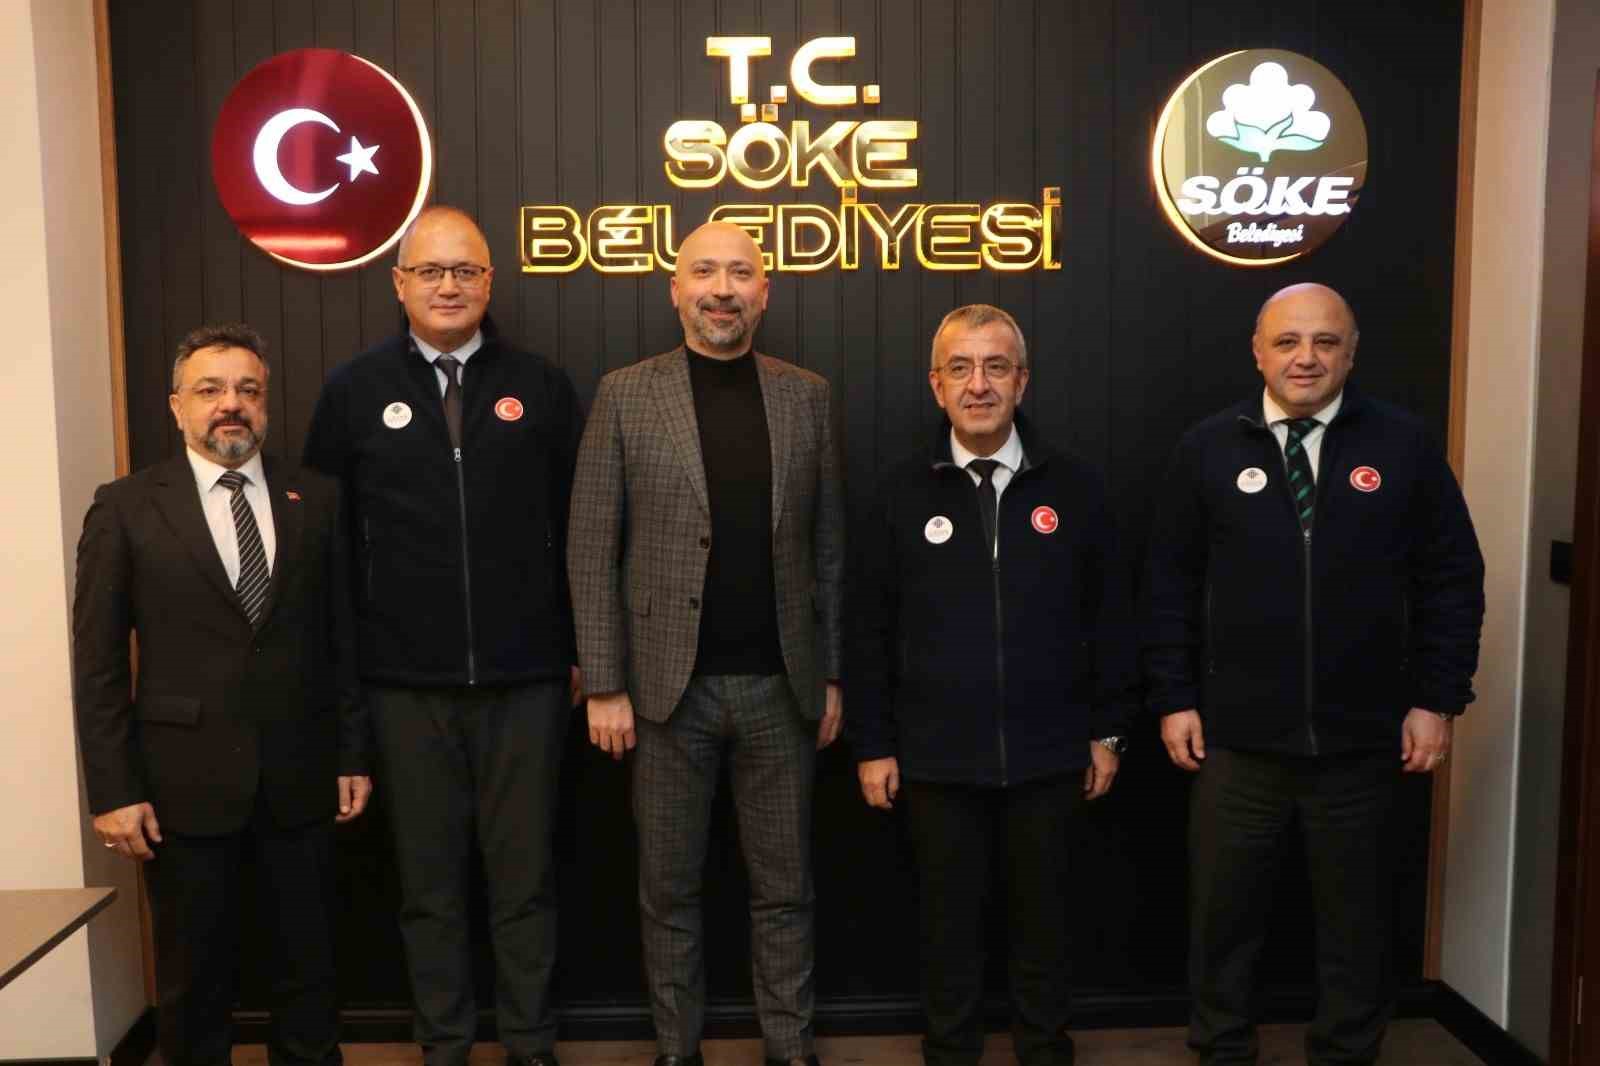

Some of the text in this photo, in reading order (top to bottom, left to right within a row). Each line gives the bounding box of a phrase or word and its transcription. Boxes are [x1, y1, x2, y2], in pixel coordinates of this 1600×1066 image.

[706, 36, 881, 104] T.C.
[664, 104, 918, 188] SÖKE
[1177, 167, 1354, 215] SÖKE
